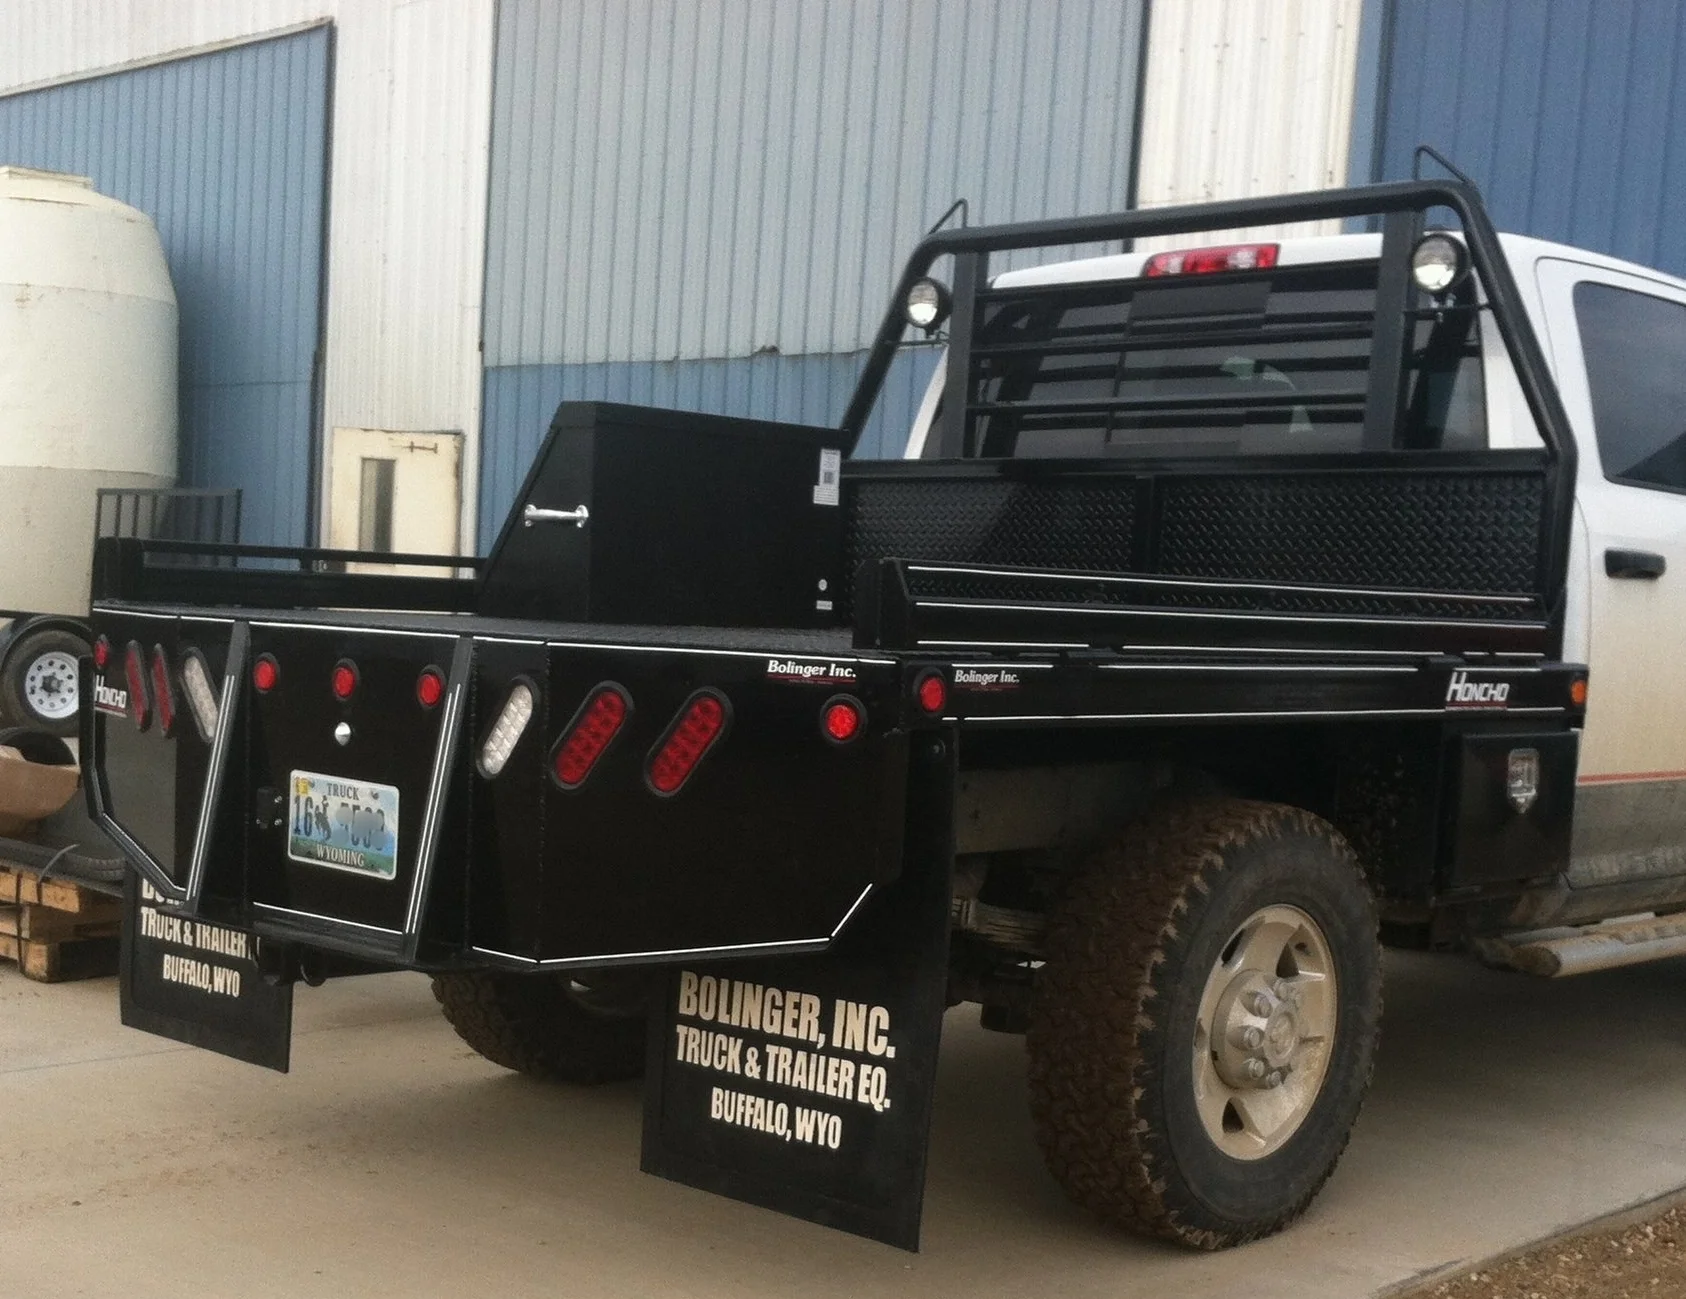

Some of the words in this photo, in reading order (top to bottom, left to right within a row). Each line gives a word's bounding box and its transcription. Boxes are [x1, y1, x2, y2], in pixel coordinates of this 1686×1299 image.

[767, 660, 827, 678] Bolinger
[829, 666, 857, 678] Inc.
[954, 670, 999, 685] Bolinger
[1000, 671, 1020, 684] Inc.
[327, 783, 360, 800] TRUCK
[293, 795, 314, 837] 16
[316, 844, 365, 867] WYOMING
[140, 906, 181, 943] TRUCK
[182, 921, 194, 946] &
[678, 970, 826, 1049] BOLINGER,
[832, 999, 896, 1059] INC.
[676, 1024, 744, 1075] TRUCK
[744, 1046, 762, 1080] &
[765, 1043, 856, 1100] TRAILER
[857, 1063, 892, 1113] EQ.
